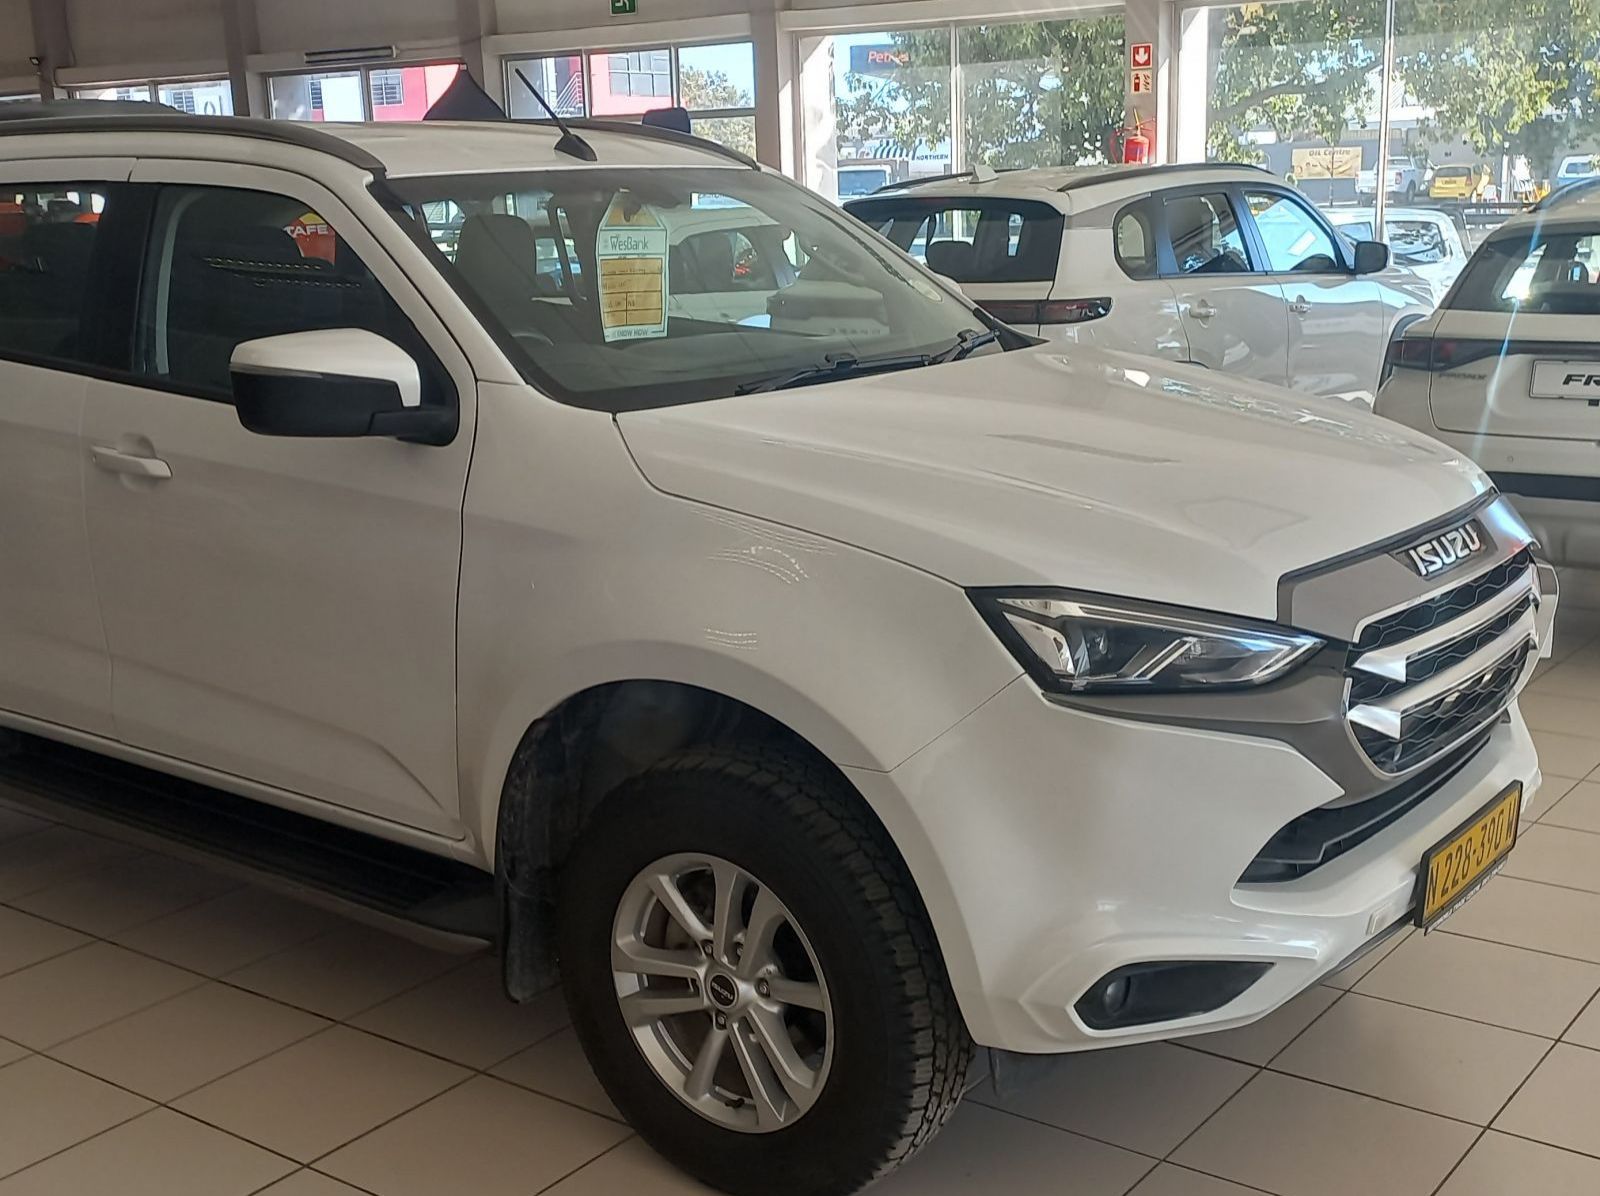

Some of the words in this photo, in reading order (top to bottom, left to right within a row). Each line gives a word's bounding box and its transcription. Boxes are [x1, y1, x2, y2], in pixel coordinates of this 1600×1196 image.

[610, 235, 648, 251] WesBank
[1408, 523, 1481, 577] ISUZU
[1427, 860, 1440, 911] N
[1440, 808, 1505, 898] 228-390
